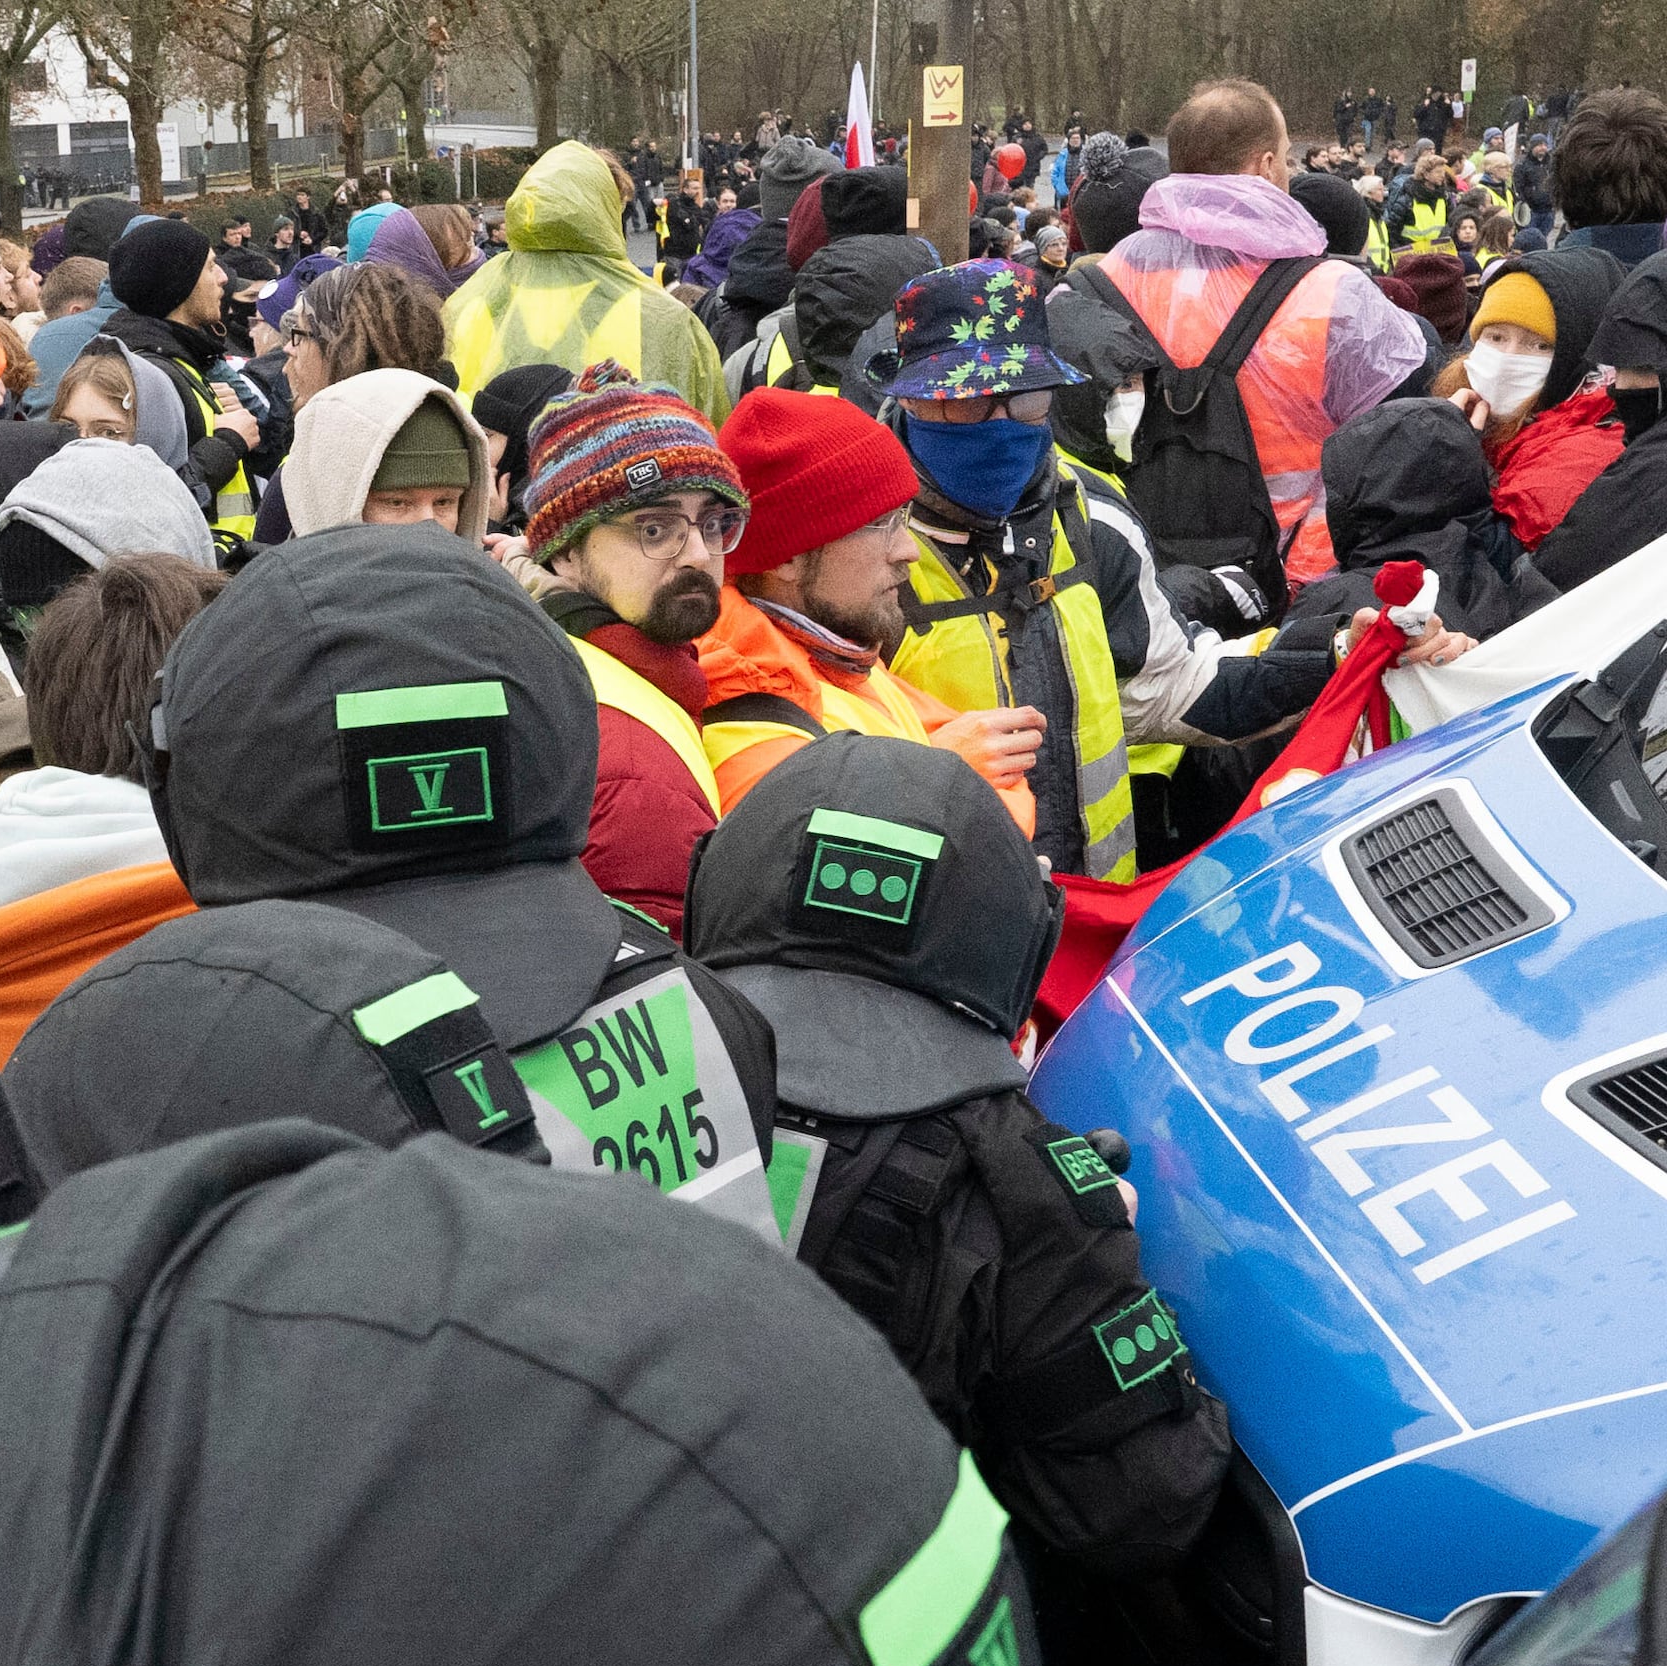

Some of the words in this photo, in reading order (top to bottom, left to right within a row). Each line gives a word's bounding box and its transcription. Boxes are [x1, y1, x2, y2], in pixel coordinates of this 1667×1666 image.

[407, 763, 454, 819] V
[454, 1060, 509, 1130] V
[557, 998, 669, 1110] BW
[1180, 941, 1578, 1285] POLIZEI
